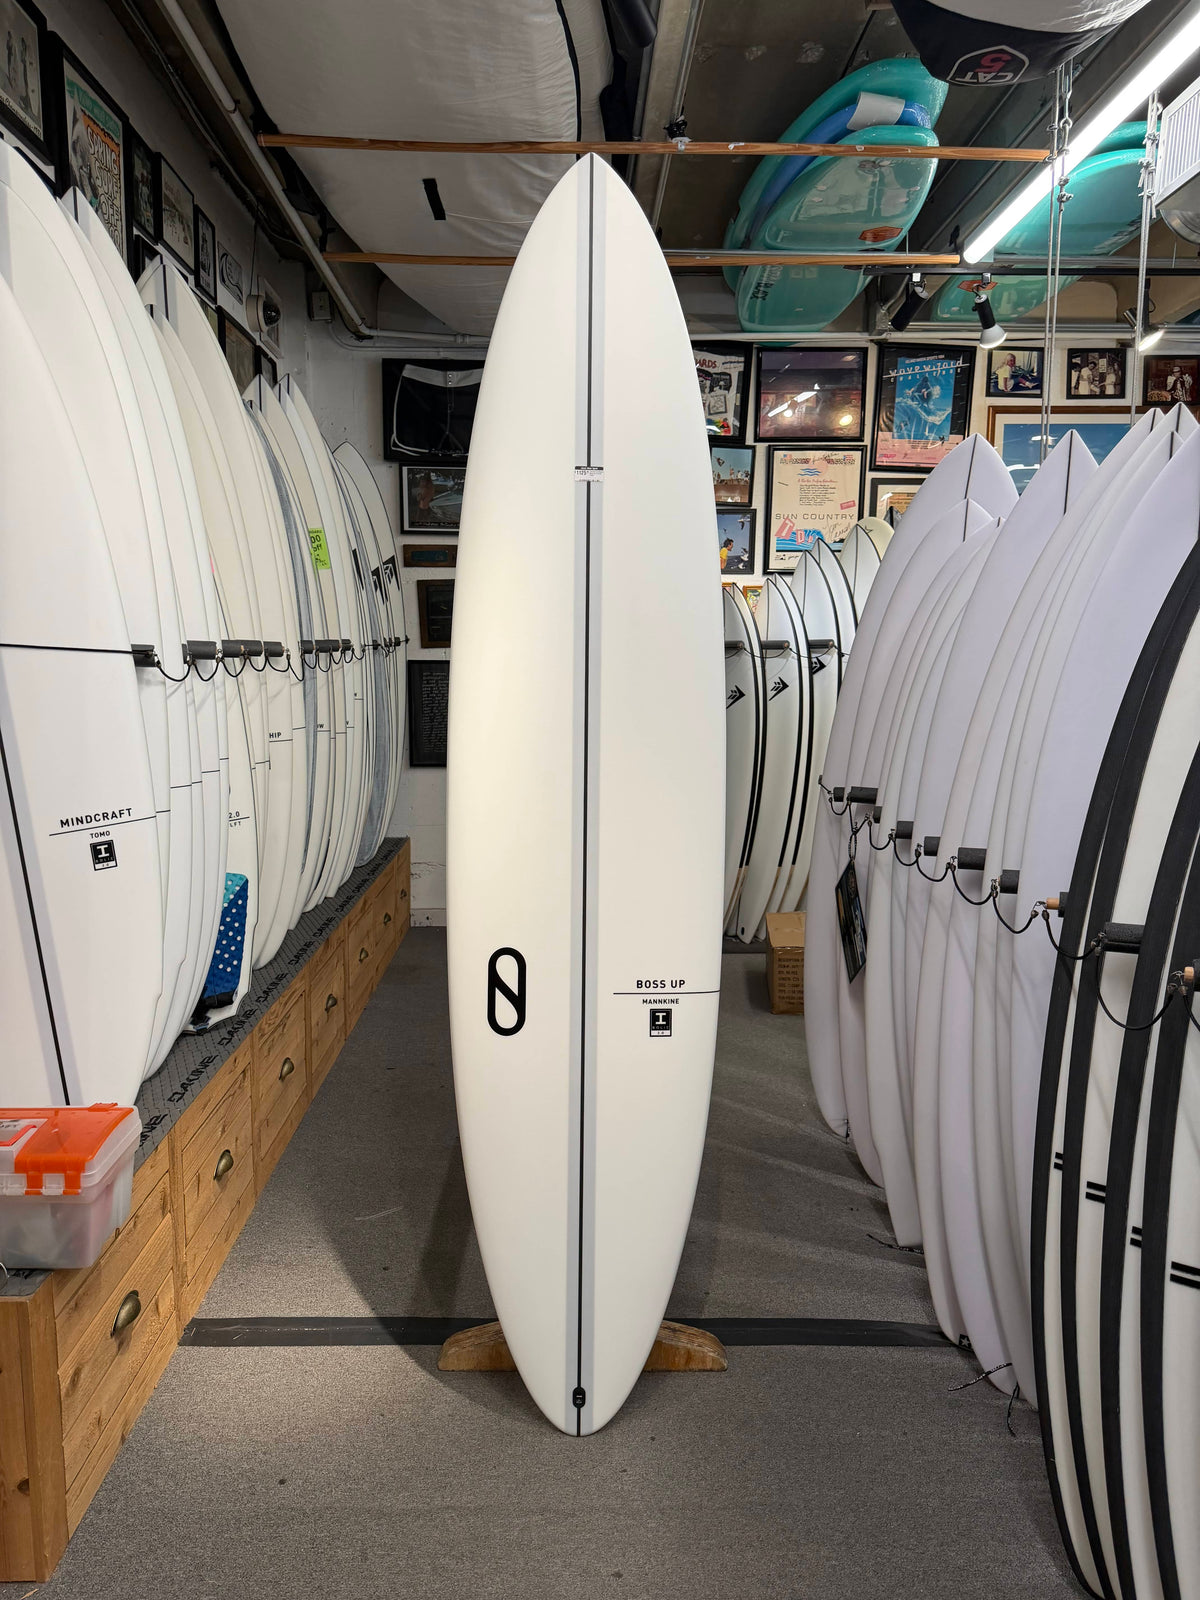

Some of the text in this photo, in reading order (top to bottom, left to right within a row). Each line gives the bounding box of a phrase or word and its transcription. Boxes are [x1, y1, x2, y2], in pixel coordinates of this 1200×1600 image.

[974, 53, 1012, 73] 5
[955, 72, 1014, 83] CAT
[60, 807, 133, 829] MINDCRAFT
[90, 830, 111, 839] TOMO
[636, 979, 686, 989] BOSS UP
[217, 1008, 259, 1046] DAKINE
[167, 1054, 219, 1103] DAKINE
